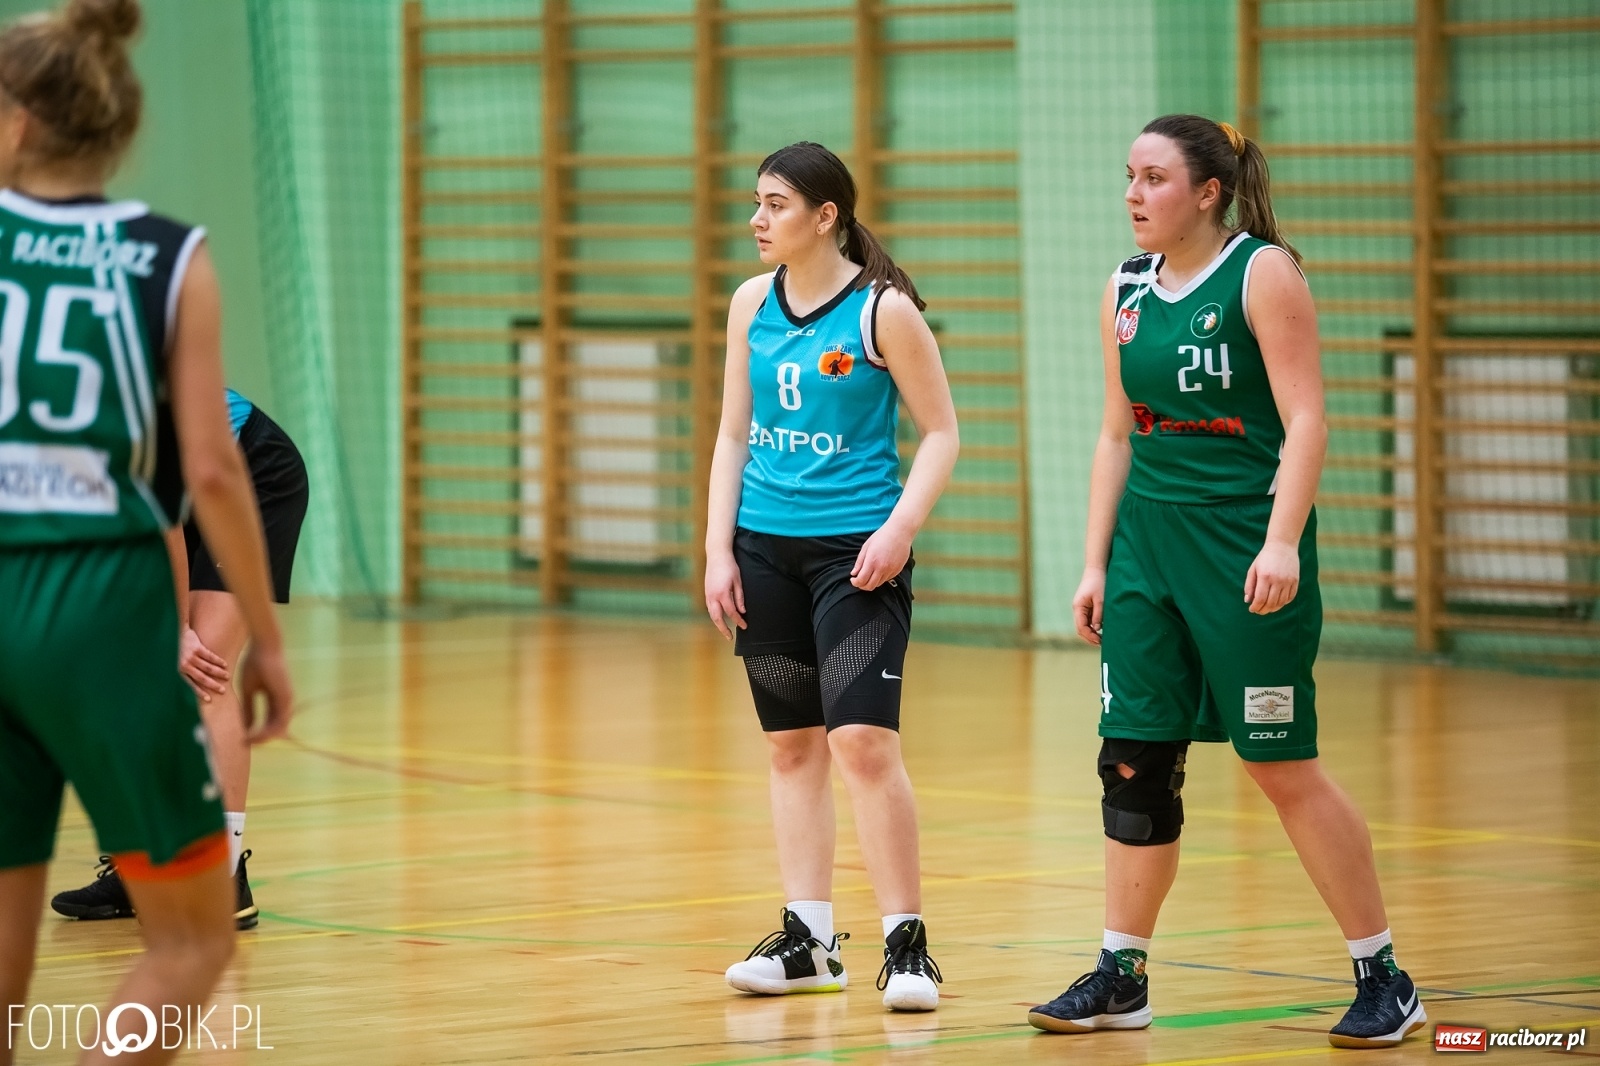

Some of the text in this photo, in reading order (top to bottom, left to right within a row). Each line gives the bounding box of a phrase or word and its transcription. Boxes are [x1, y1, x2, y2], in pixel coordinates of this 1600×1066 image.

[777, 362, 802, 411] 8
[1178, 343, 1233, 392] 24
[1249, 731, 1288, 740] COLO
